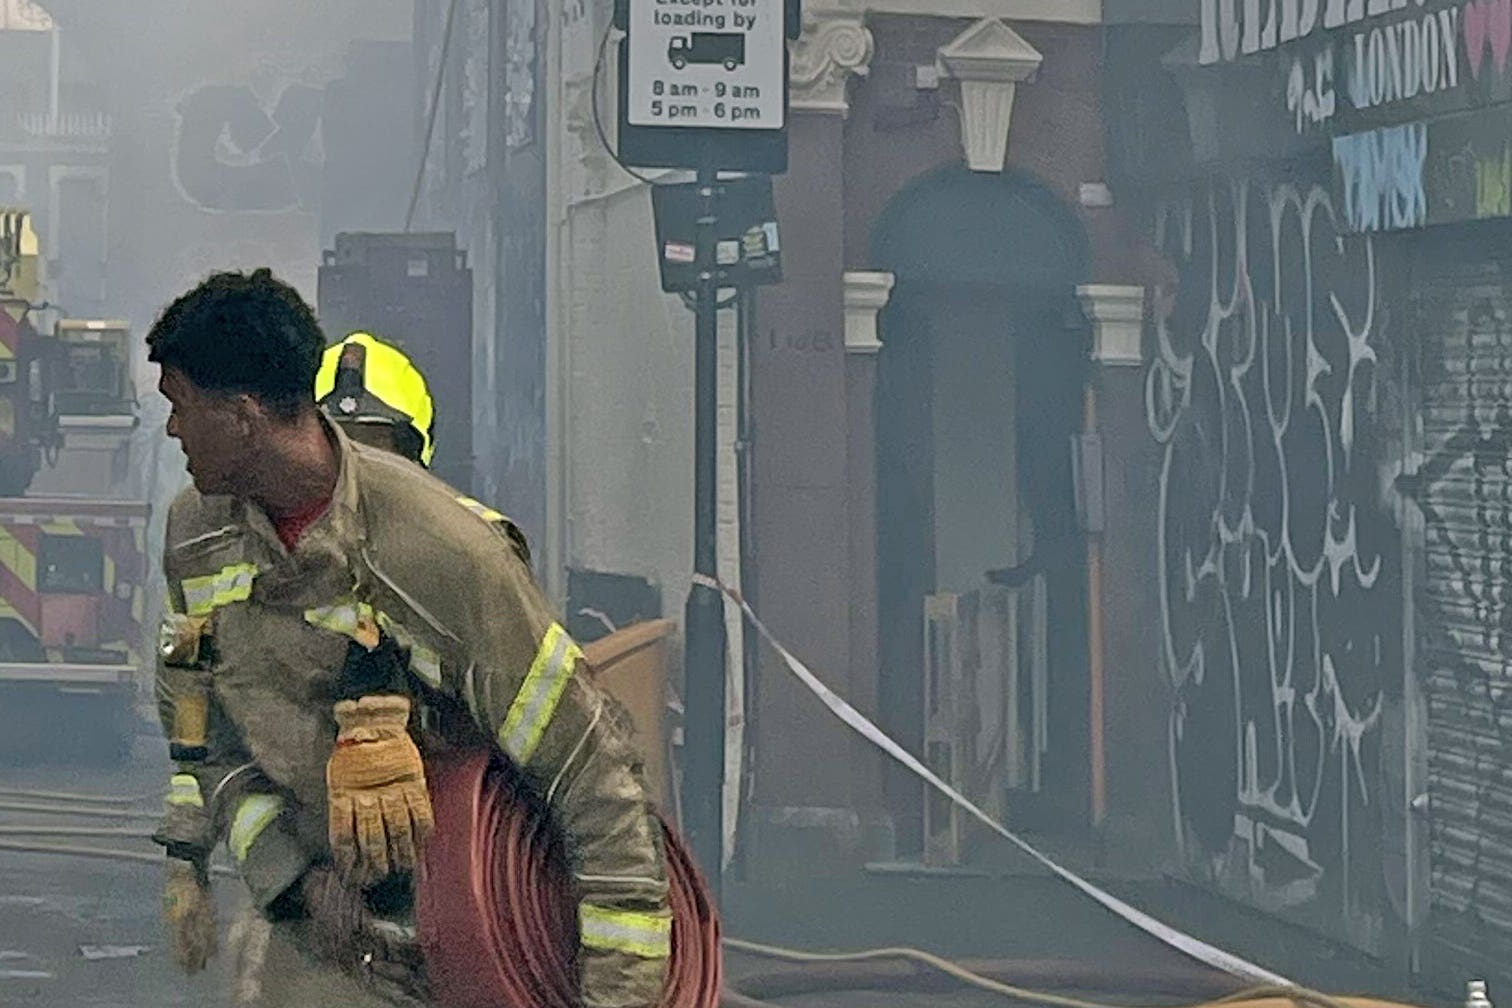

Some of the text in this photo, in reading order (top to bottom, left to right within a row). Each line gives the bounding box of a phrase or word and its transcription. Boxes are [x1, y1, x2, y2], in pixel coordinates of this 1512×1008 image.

[654, 9, 757, 31] loading by
[1353, 6, 1459, 110] LONDON
[653, 80, 664, 96] 8
[670, 84, 698, 96] am
[714, 81, 726, 98] 9
[731, 86, 761, 99] am
[651, 100, 663, 117] 5
[668, 104, 698, 119] pm
[714, 101, 726, 119] 6
[731, 106, 761, 121] pm
